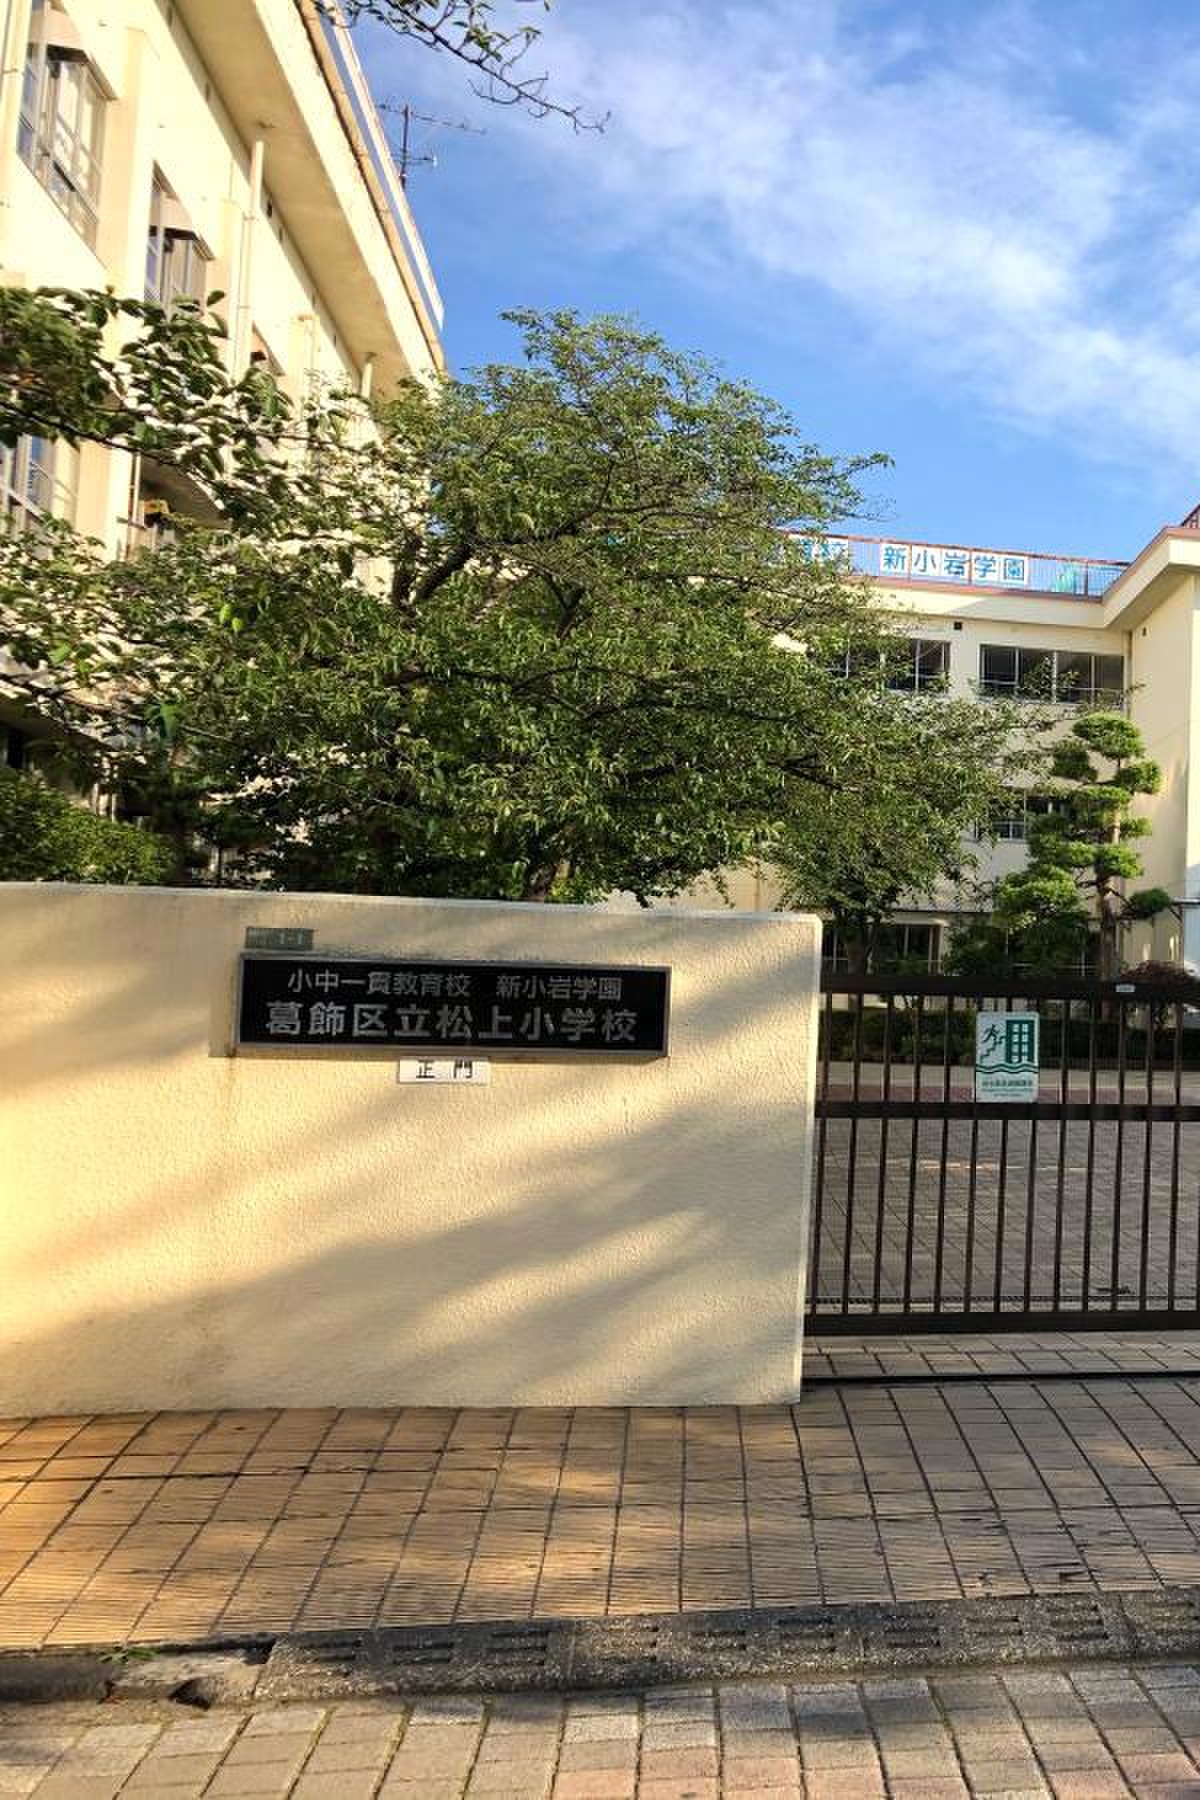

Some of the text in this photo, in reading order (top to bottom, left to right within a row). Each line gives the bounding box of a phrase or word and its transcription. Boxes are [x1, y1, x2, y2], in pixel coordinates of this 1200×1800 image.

[883, 545, 1026, 582] 新小岩学園
[287, 967, 623, 1001] 小中一貫教育校 新小岩学園
[266, 1000, 639, 1042] 葛飾区立松上小学校
[415, 1059, 473, 1079] 正門
